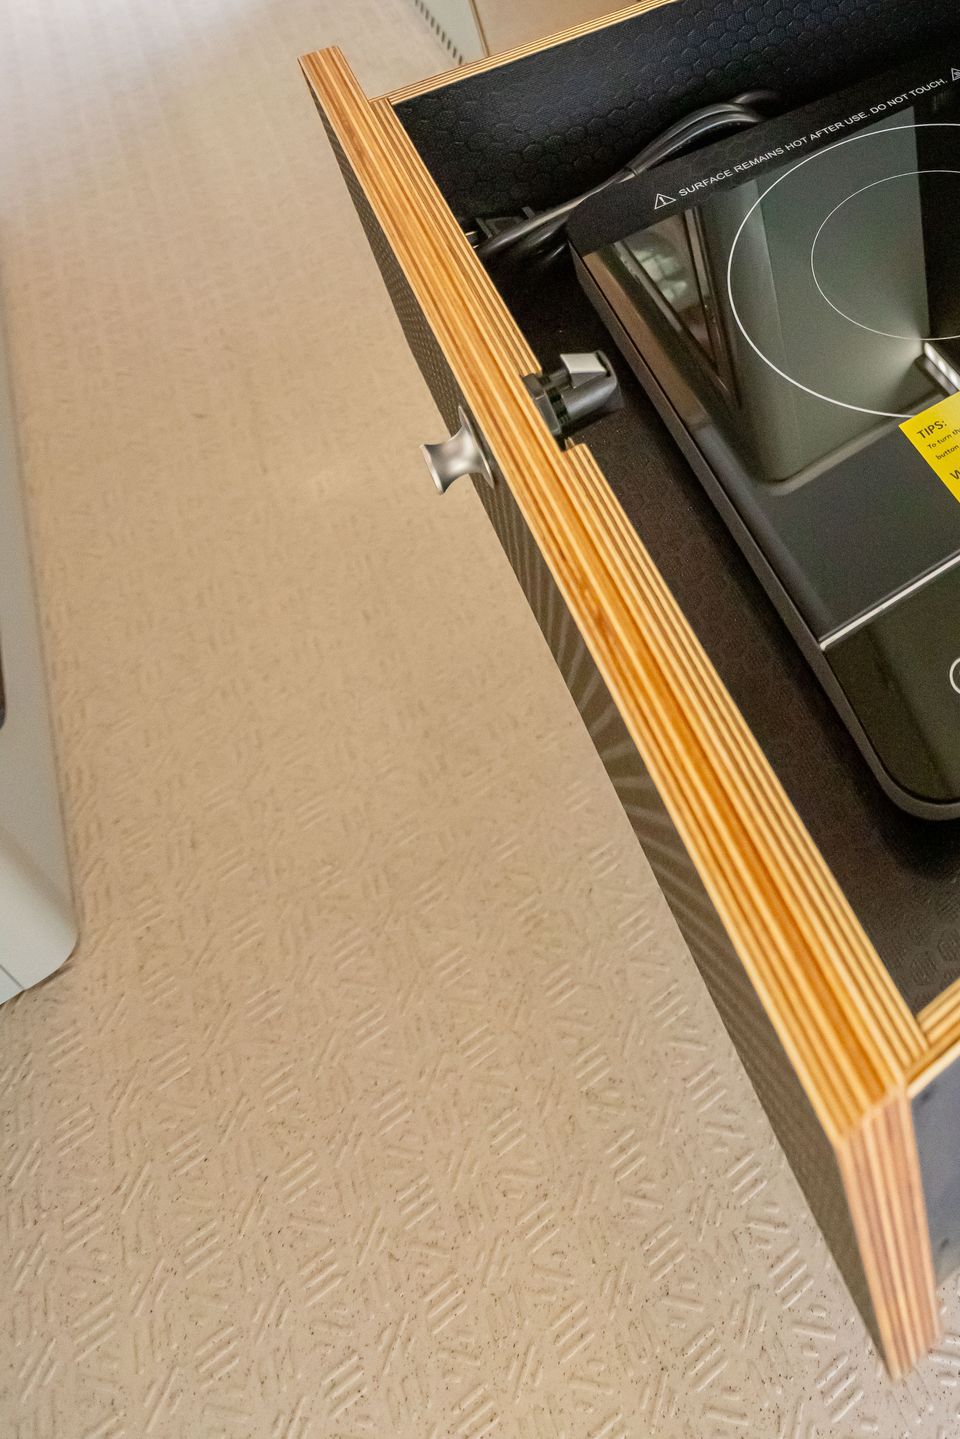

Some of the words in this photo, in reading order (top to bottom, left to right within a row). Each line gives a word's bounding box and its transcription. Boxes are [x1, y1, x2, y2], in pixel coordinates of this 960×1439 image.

[679, 169, 733, 196] SURFACE
[733, 147, 784, 173] REMAINS
[785, 136, 808, 151] HOT
[810, 122, 845, 140] AFTER
[844, 112, 870, 125] USE.
[870, 103, 886, 114] DO
[887, 93, 910, 107] NOT
[908, 78, 948, 97] TOUCH.
[917, 419, 948, 440] TIPS:
[937, 435, 952, 446] turn
